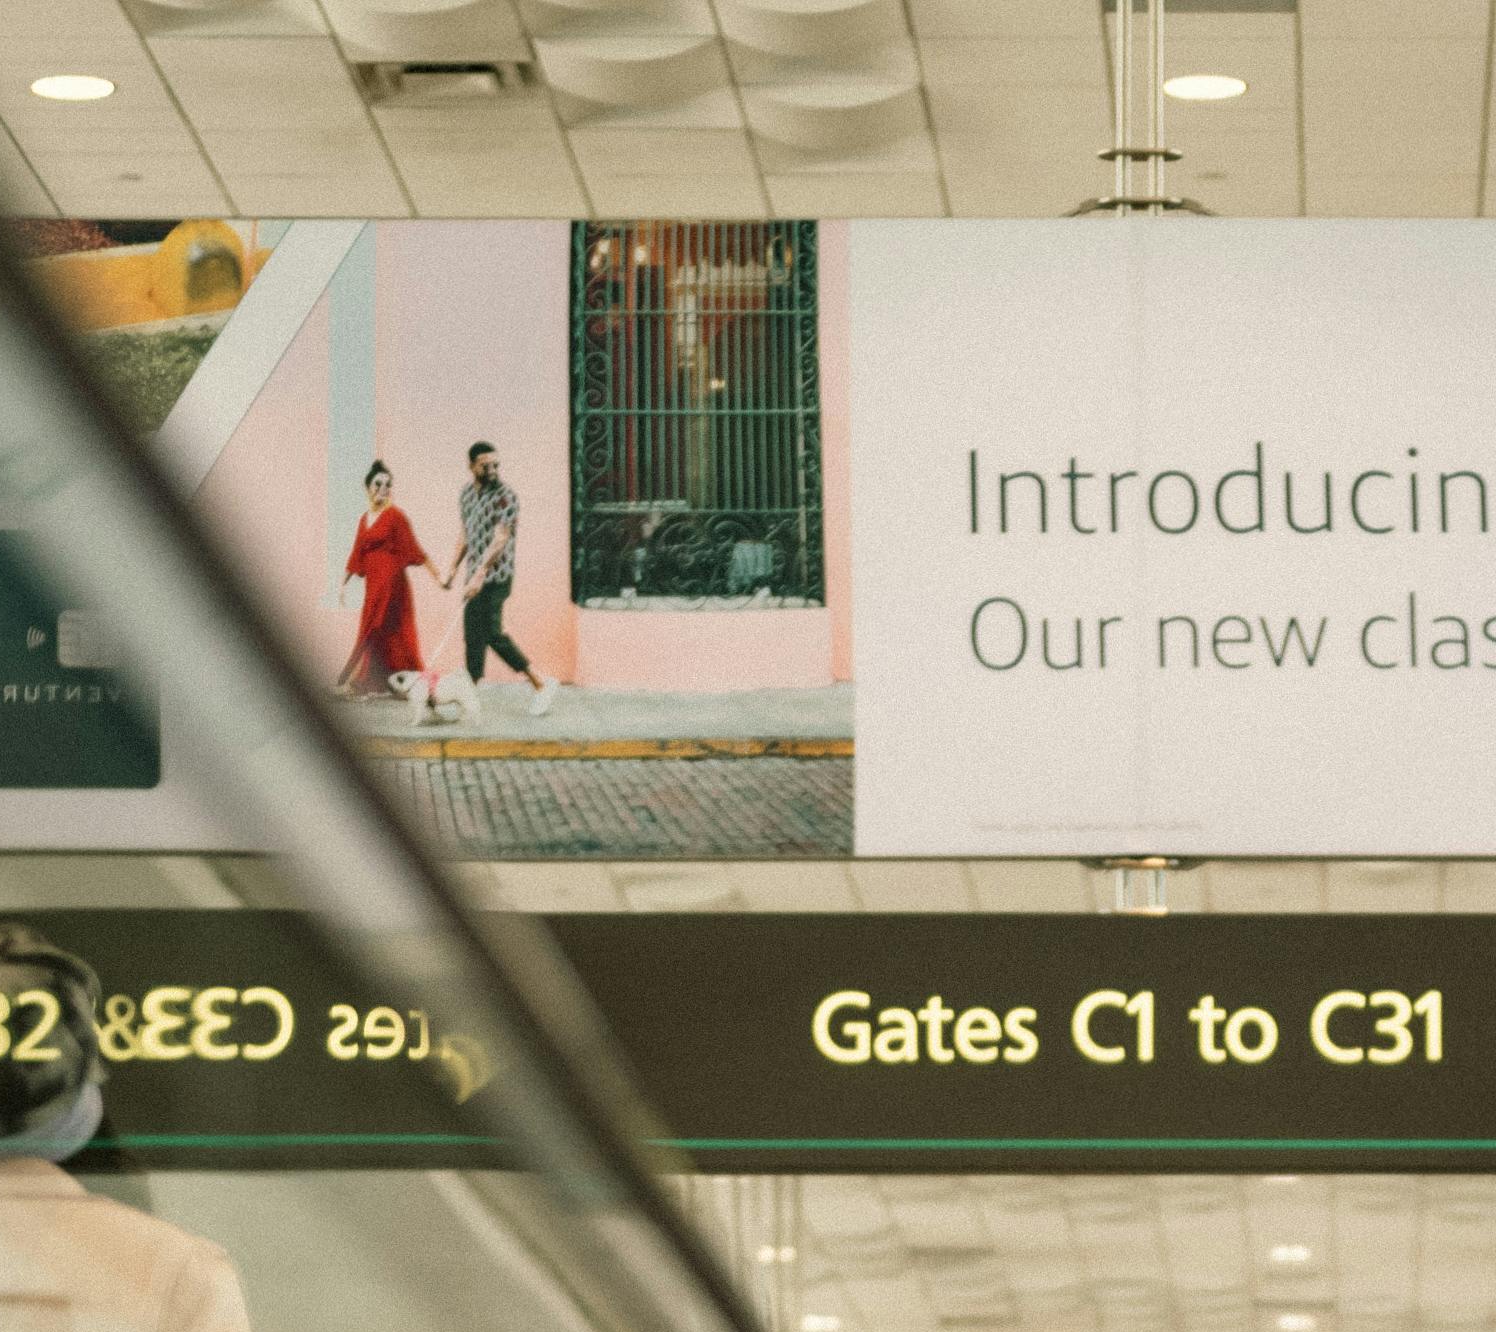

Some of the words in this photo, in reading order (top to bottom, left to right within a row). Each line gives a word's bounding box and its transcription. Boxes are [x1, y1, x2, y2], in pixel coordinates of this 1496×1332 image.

[970, 595, 1124, 671] Our
[1158, 614, 1328, 670] new
[812, 989, 1039, 1065] Gates
[1071, 988, 1155, 1065] C1
[1188, 994, 1279, 1065] to
[1310, 988, 1443, 1065] C31
